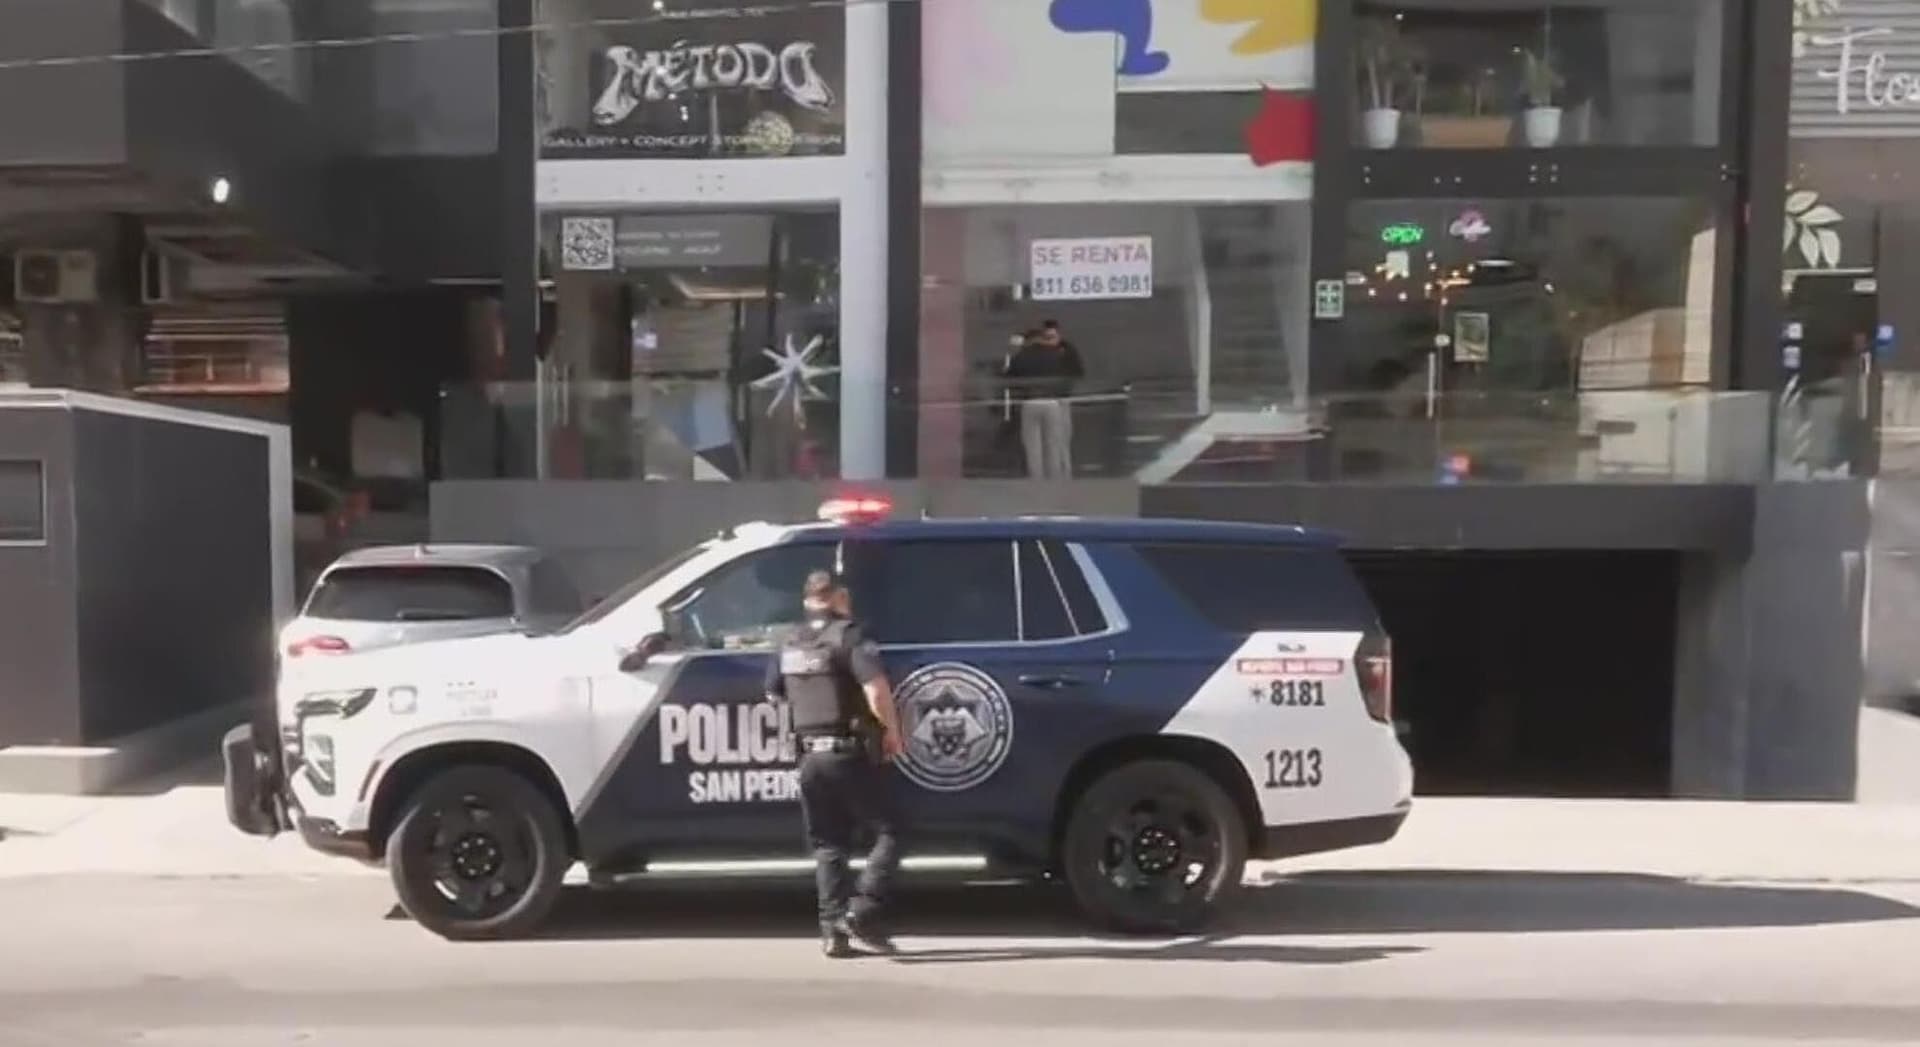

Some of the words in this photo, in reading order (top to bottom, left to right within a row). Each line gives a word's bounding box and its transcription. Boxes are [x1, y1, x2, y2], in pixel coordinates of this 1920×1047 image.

[592, 40, 834, 125] MÉTODO
[633, 134, 708, 148] CONCEPT
[1034, 247, 1063, 265] SE
[1071, 245, 1149, 263] RENTA
[1034, 277, 1064, 295] 811
[1270, 679, 1326, 706] 8181
[1264, 748, 1323, 789] 1213
[689, 770, 742, 803] SAN
[745, 769, 800, 801] PEDR
